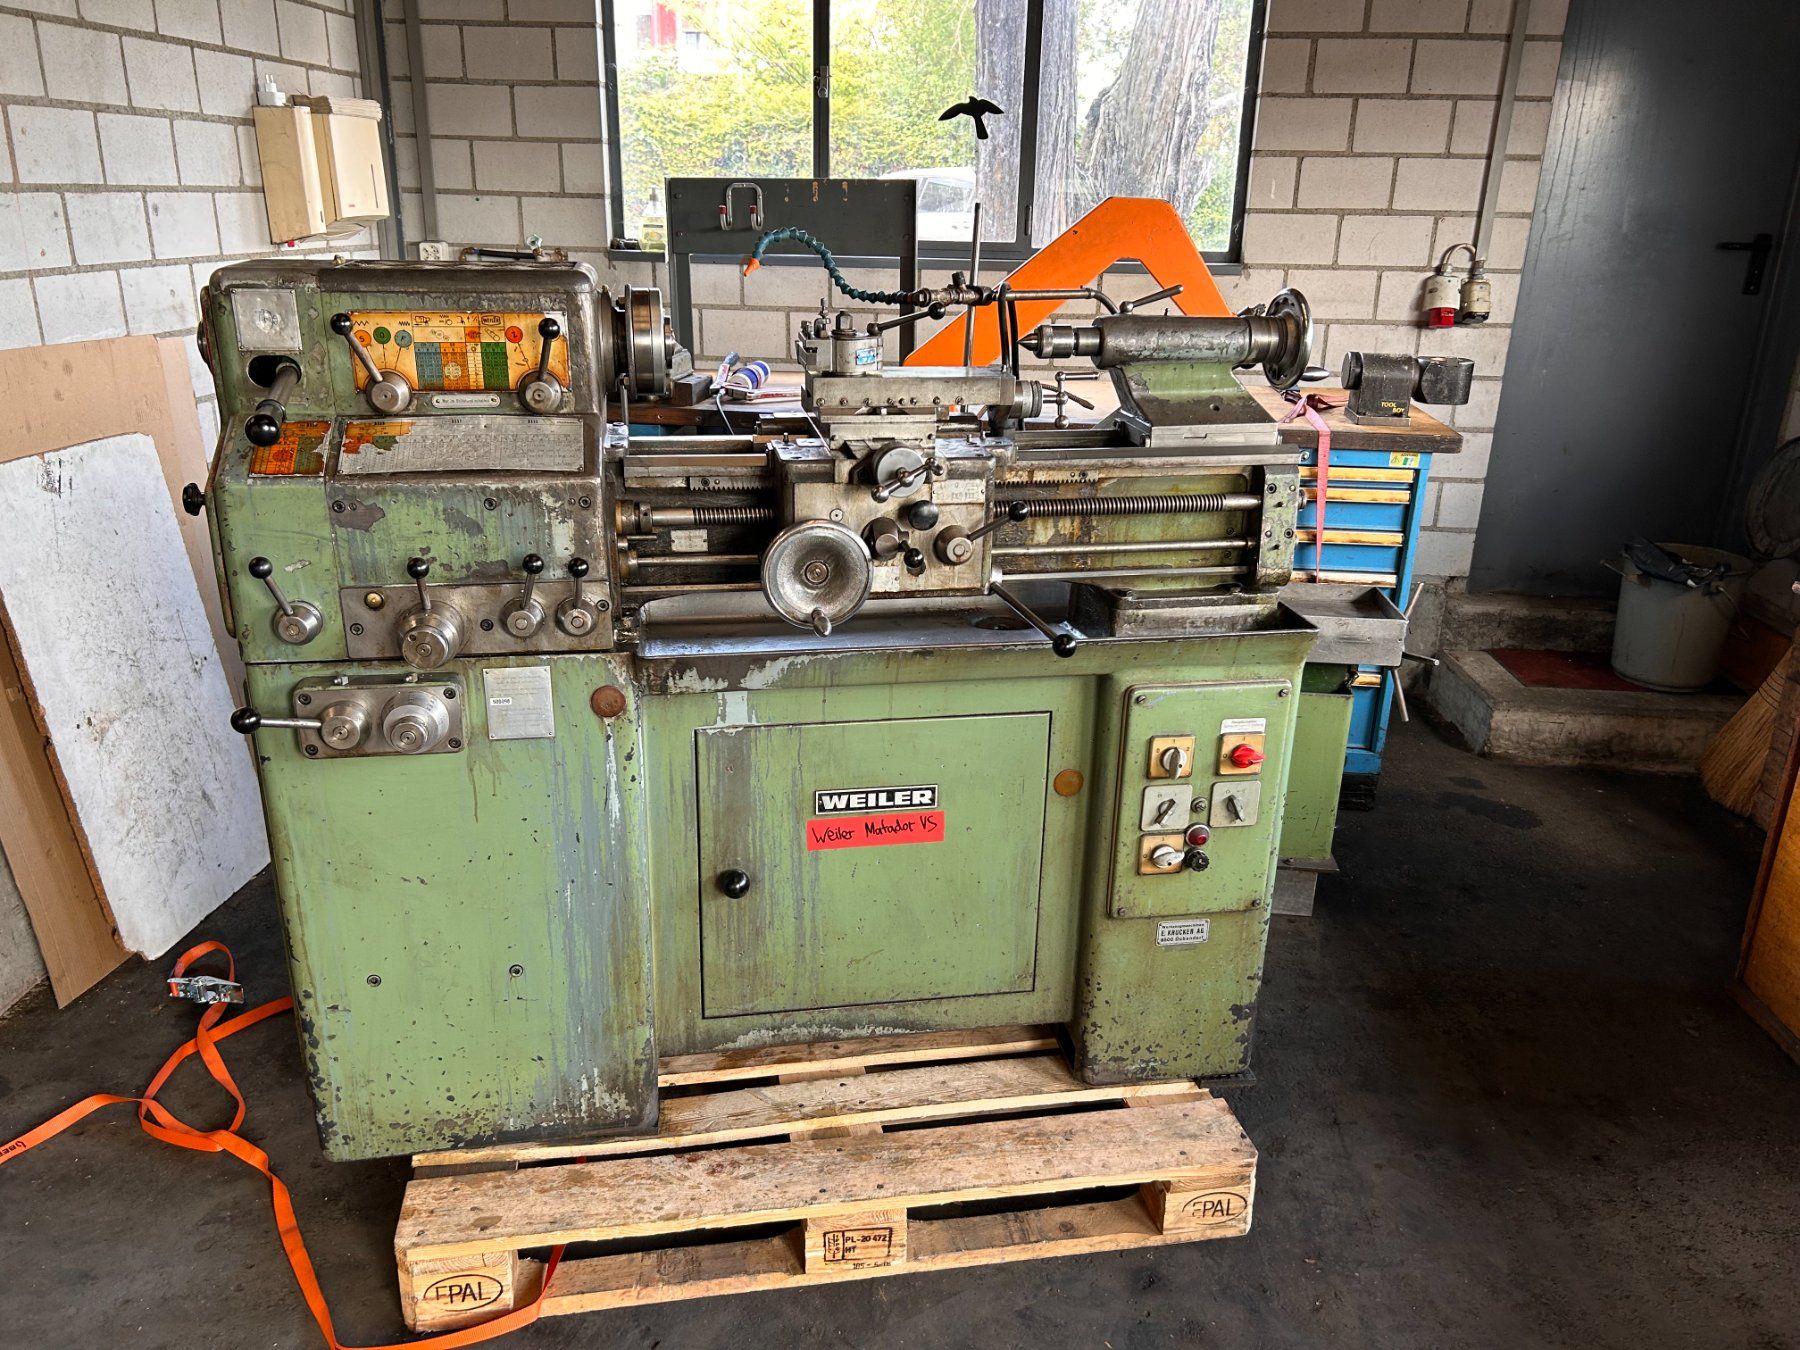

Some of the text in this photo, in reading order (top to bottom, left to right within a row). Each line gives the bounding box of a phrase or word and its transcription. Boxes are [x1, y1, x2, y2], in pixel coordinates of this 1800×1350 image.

[821, 790, 933, 810] WEILER
[811, 815, 938, 844] Weiler Matador VS
